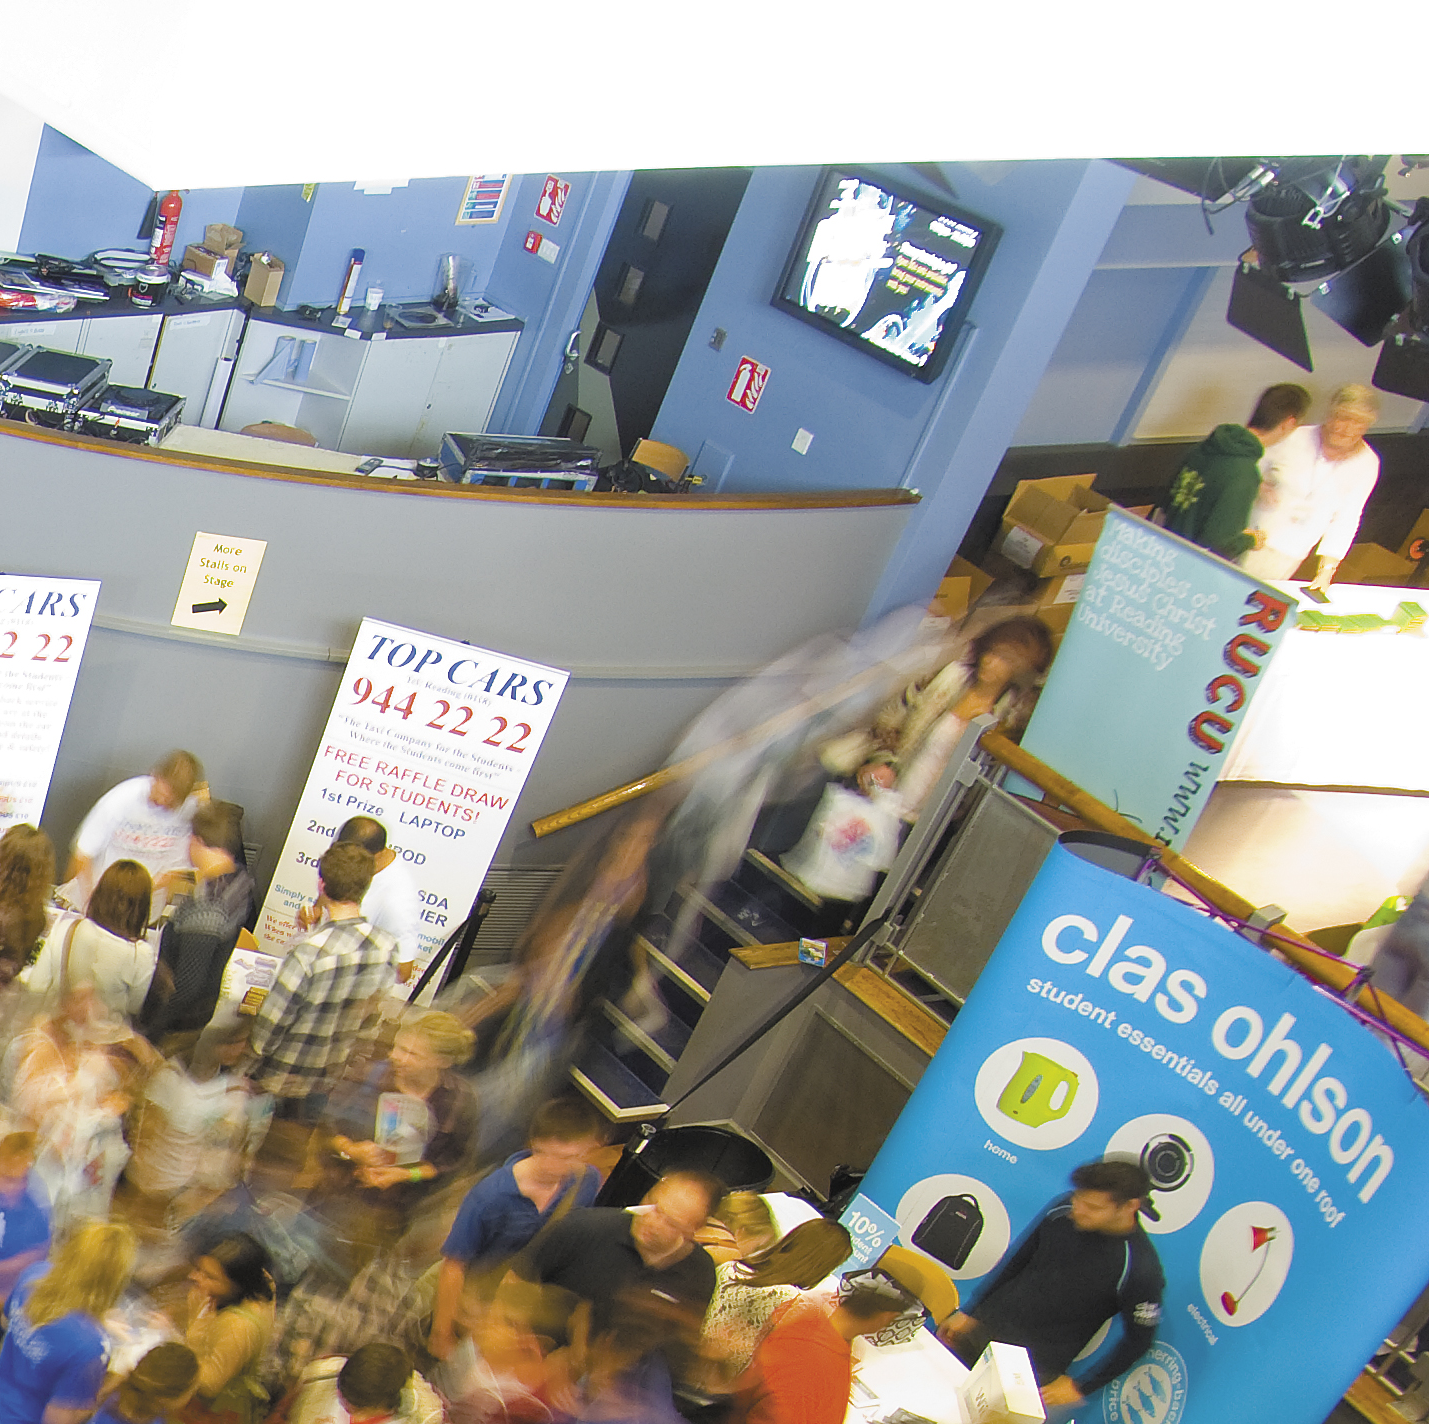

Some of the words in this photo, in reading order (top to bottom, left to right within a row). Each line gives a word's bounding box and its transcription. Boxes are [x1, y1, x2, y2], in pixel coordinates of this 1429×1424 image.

[199, 557, 229, 570] Stalls
[233, 564, 247, 573] on
[213, 543, 242, 556] More
[1112, 522, 1178, 572] Making
[203, 574, 234, 588] Stage
[1101, 543, 1191, 598] disciples
[1191, 592, 1220, 610] of
[1077, 602, 1175, 671] University
[1085, 584, 1105, 607] at
[1110, 594, 1186, 656] Reading
[1152, 592, 1216, 640] Christ
[31, 633, 73, 662] 22
[367, 634, 443, 673] TOP
[447, 659, 554, 706] CARS
[1187, 589, 1289, 755] RUCU
[350, 677, 417, 720] 944
[425, 699, 473, 736] 22
[482, 716, 532, 754] 22
[387, 728, 432, 751] Company
[324, 745, 372, 770] FREE
[375, 760, 447, 793] RAFFLE
[450, 783, 509, 810] DRAW
[335, 769, 373, 791] FOR
[377, 781, 481, 824] STUDENTS!
[307, 819, 337, 838] 2nd
[321, 787, 341, 804] 1st
[345, 795, 384, 817] Prize
[399, 811, 466, 840] LAPTOP
[274, 883, 306, 902] Simply
[283, 899, 301, 910] and
[1041, 914, 1207, 1025] clas
[1211, 1005, 1394, 1204] ohlson
[1026, 976, 1118, 1029] student
[1116, 1016, 1220, 1096] essentials
[1219, 1089, 1250, 1117] all
[1243, 1108, 1295, 1161] under
[1291, 1157, 1320, 1196] one
[1314, 1182, 1347, 1229] roof
[983, 1139, 1018, 1165] home
[847, 1210, 885, 1249] 10%
[1187, 1303, 1219, 1346] electrical
